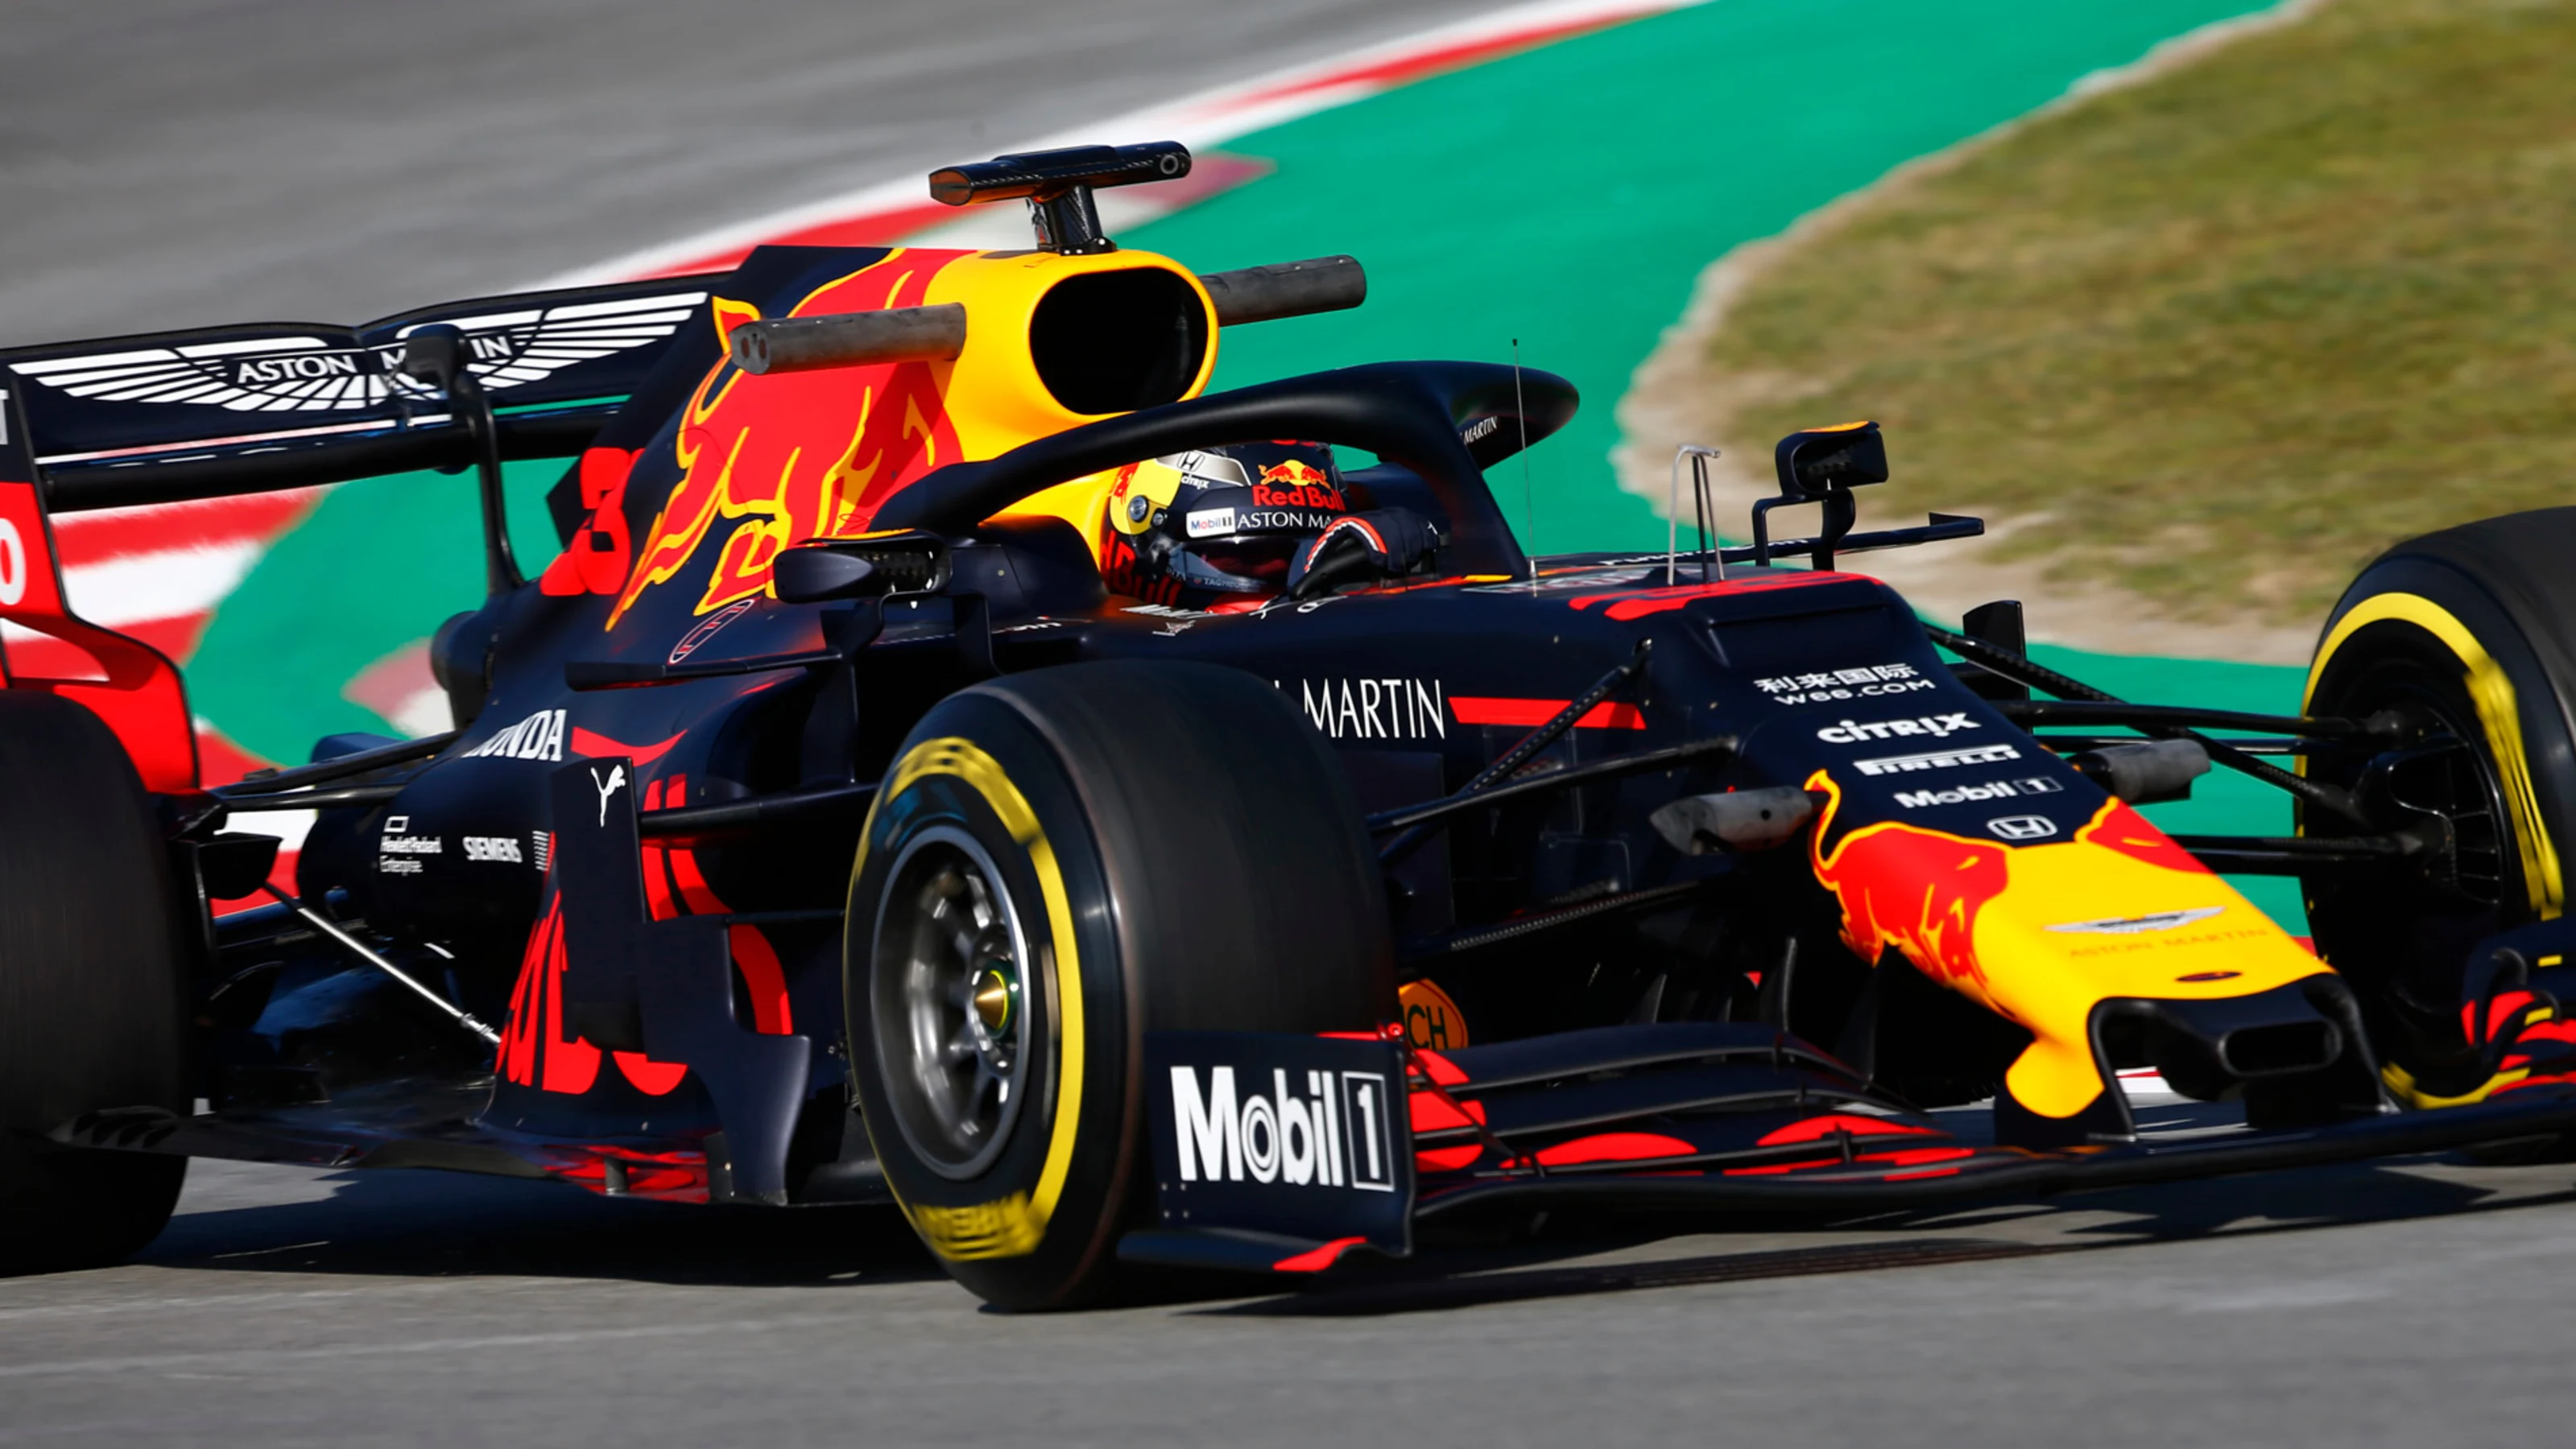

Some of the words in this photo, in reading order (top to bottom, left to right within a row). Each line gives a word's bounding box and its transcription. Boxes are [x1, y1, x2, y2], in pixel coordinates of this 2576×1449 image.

[238, 355, 358, 383] ASTON
[1252, 485, 1306, 506] Red
[1306, 488, 1346, 511] Bull
[1190, 517, 1221, 530] Mobil
[1237, 512, 1303, 529] ASTON
[1754, 663, 1919, 693] 利来国际
[1303, 678, 1445, 739] MARTIN
[1853, 744, 2021, 776] PIRELLI
[1894, 781, 2017, 808] Mobil
[1170, 1066, 1344, 1187] Mobil
